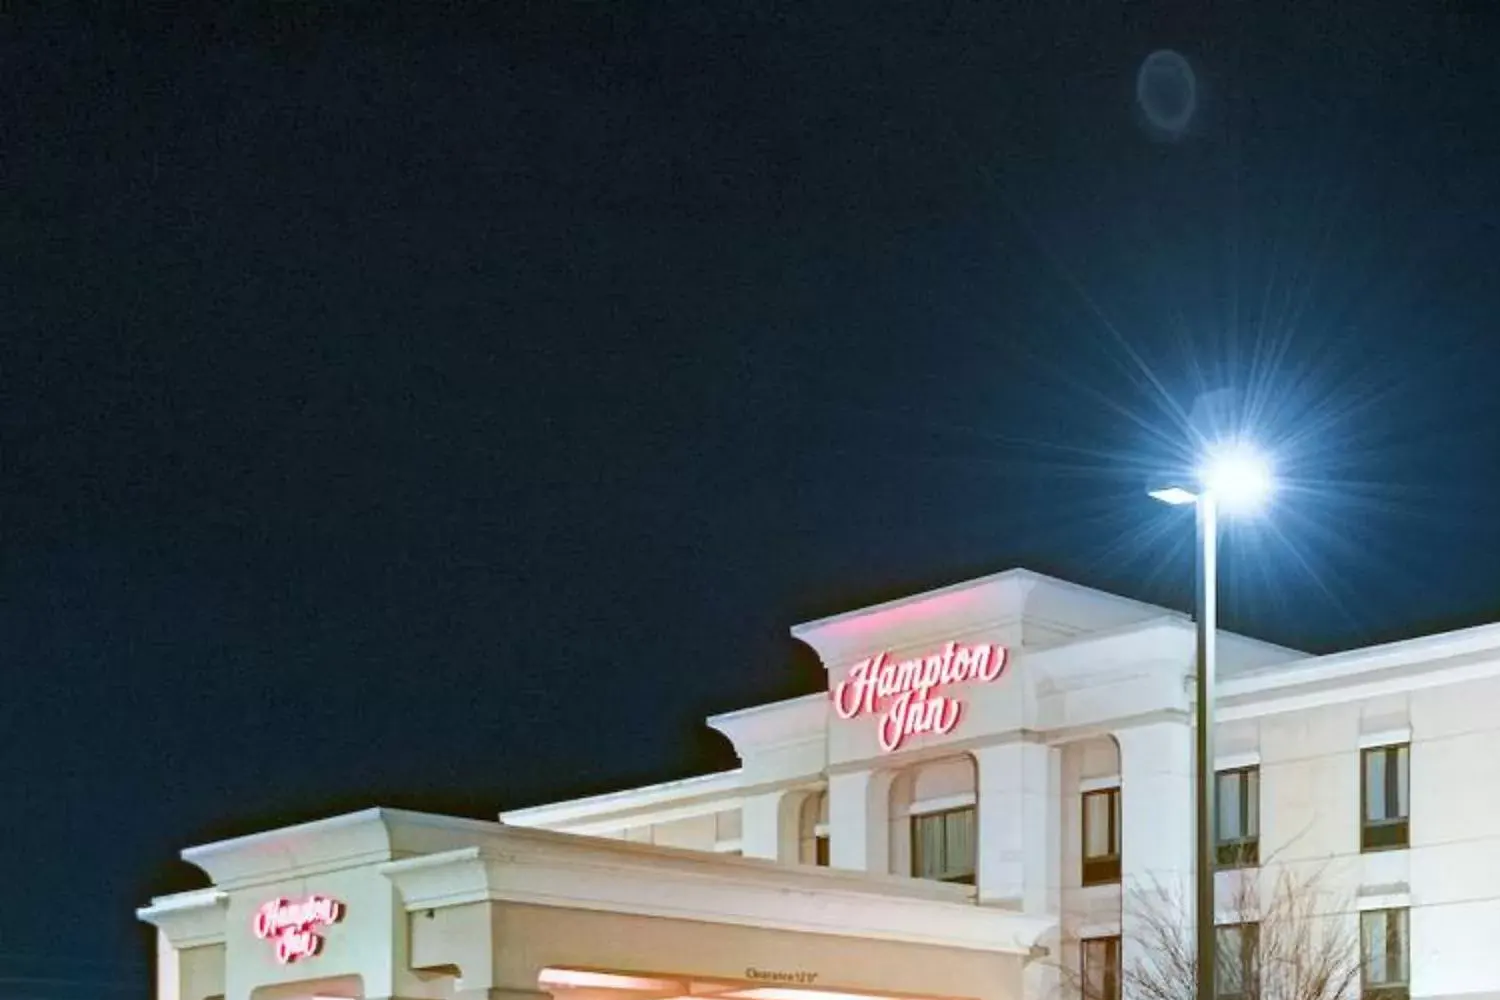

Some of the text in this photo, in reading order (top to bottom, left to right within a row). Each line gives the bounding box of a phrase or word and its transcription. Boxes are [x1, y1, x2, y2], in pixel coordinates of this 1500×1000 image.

[835, 640, 1006, 718] Hampton
[878, 690, 960, 751] Inn
[254, 896, 343, 938] Hampton
